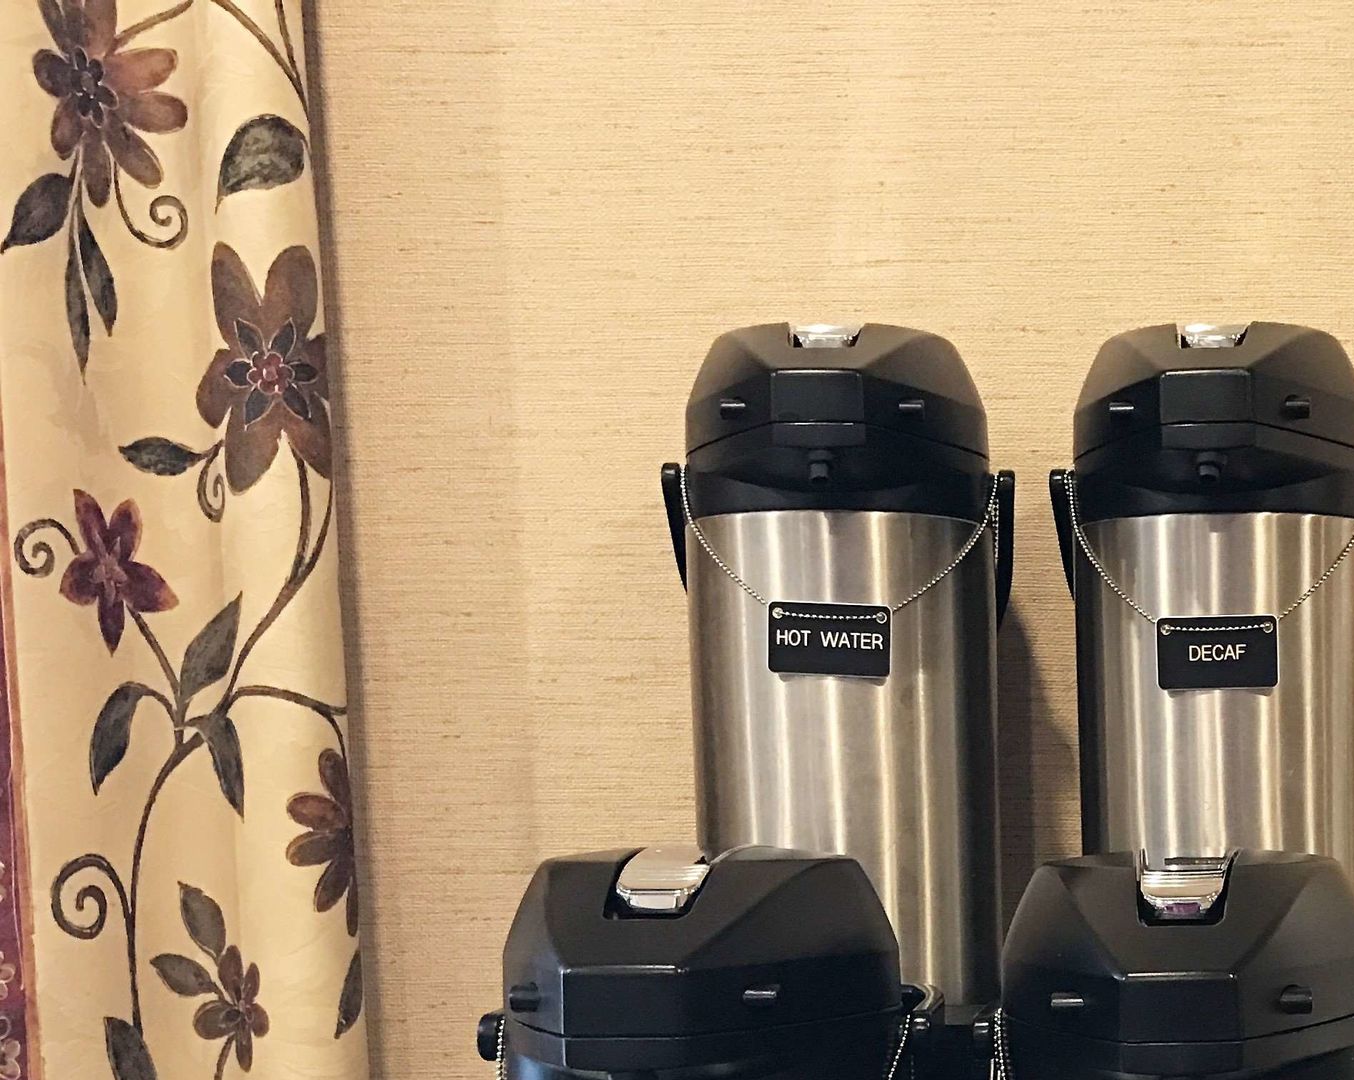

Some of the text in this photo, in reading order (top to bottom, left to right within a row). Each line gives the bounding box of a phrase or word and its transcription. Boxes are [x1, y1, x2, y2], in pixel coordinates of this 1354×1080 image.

[776, 628, 884, 650] HOT WATER
[1188, 644, 1247, 661] DECAF
